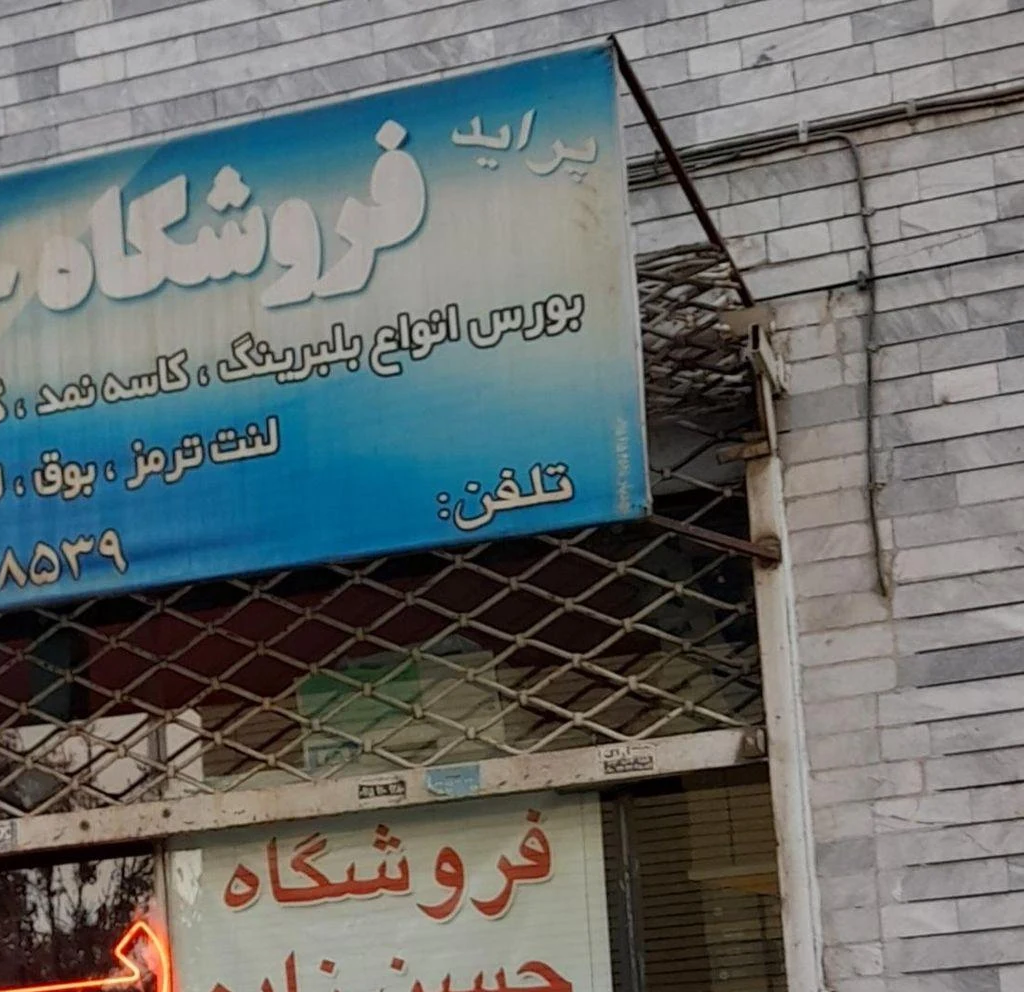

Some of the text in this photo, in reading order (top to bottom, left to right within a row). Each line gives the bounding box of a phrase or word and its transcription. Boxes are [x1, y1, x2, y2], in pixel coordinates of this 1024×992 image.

[452, 108, 598, 186] پراید
[369, 304, 460, 377] انواع
[469, 294, 584, 348] بورس
[103, 351, 189, 405] کاسه
[217, 323, 363, 383] بلبرینگ
[36, 371, 98, 418] نمد
[126, 433, 203, 489] ترمز
[209, 416, 280, 464] لنت
[33, 451, 98, 498] بوق
[437, 462, 575, 529] تلفن:
[223, 808, 553, 922] فروشگاه
